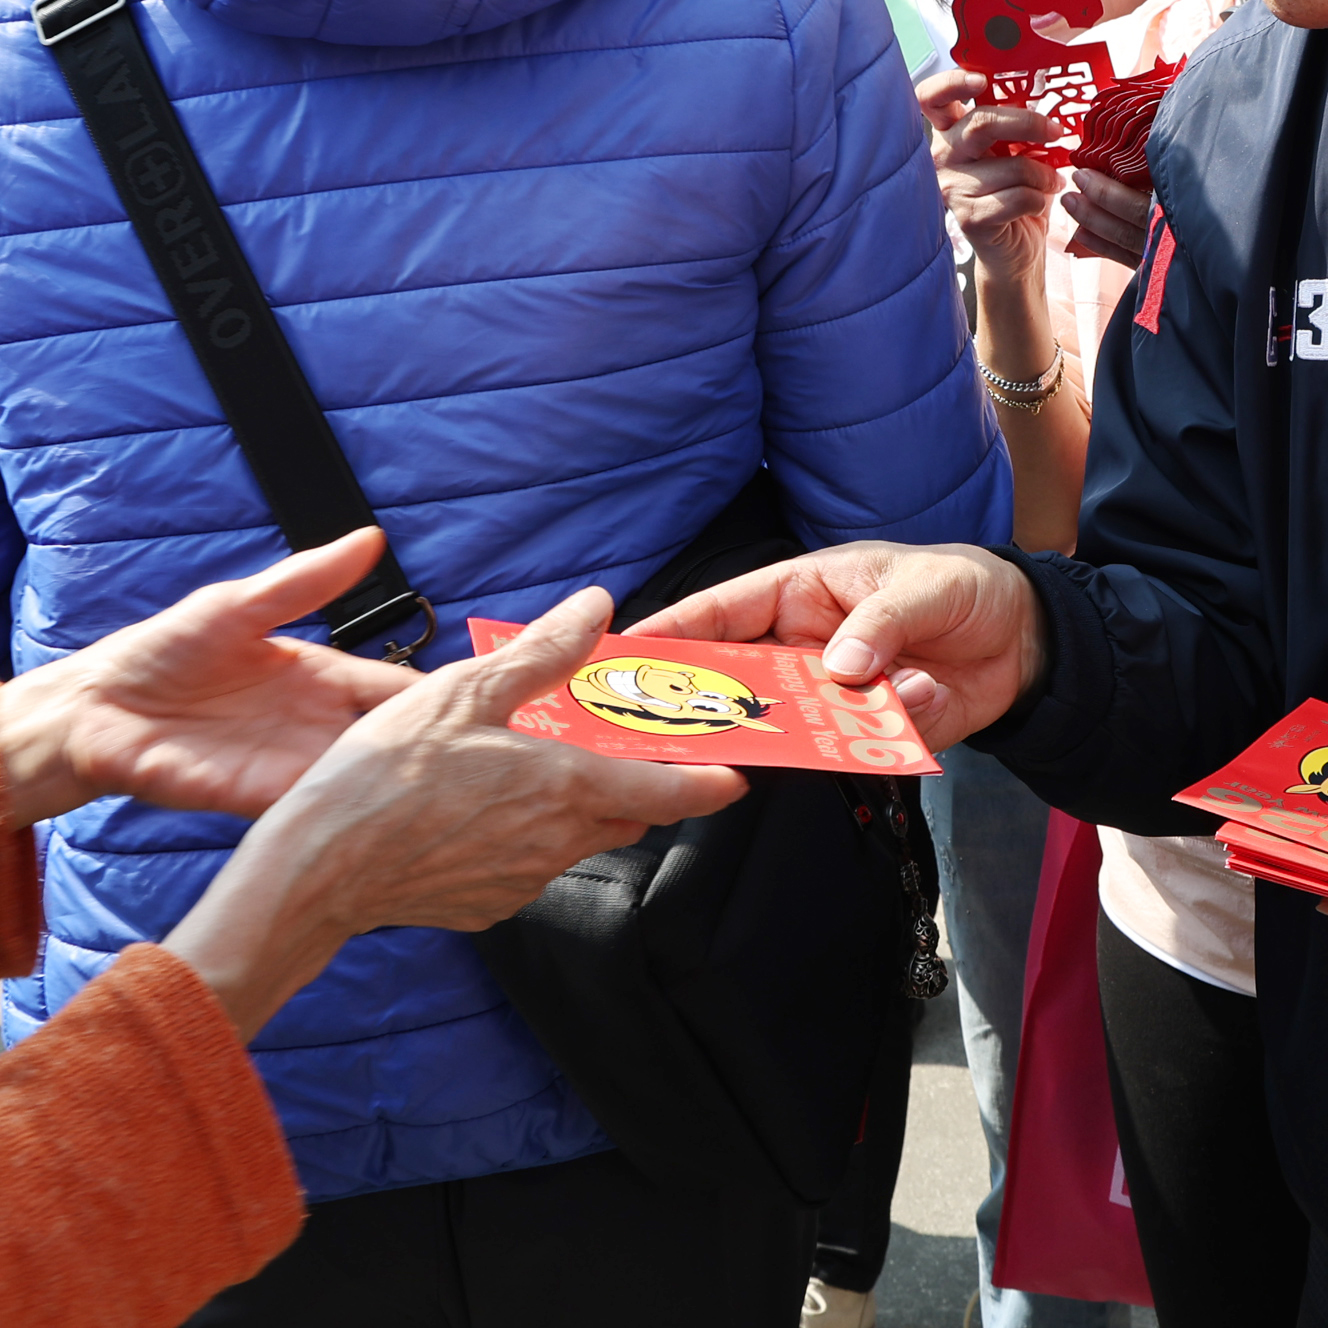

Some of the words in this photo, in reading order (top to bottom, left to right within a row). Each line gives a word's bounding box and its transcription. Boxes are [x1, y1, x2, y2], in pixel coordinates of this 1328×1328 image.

[772, 651, 808, 694] Happy
[794, 695, 826, 727] New
[811, 728, 844, 763] Year
[1222, 779, 1289, 810] Year
